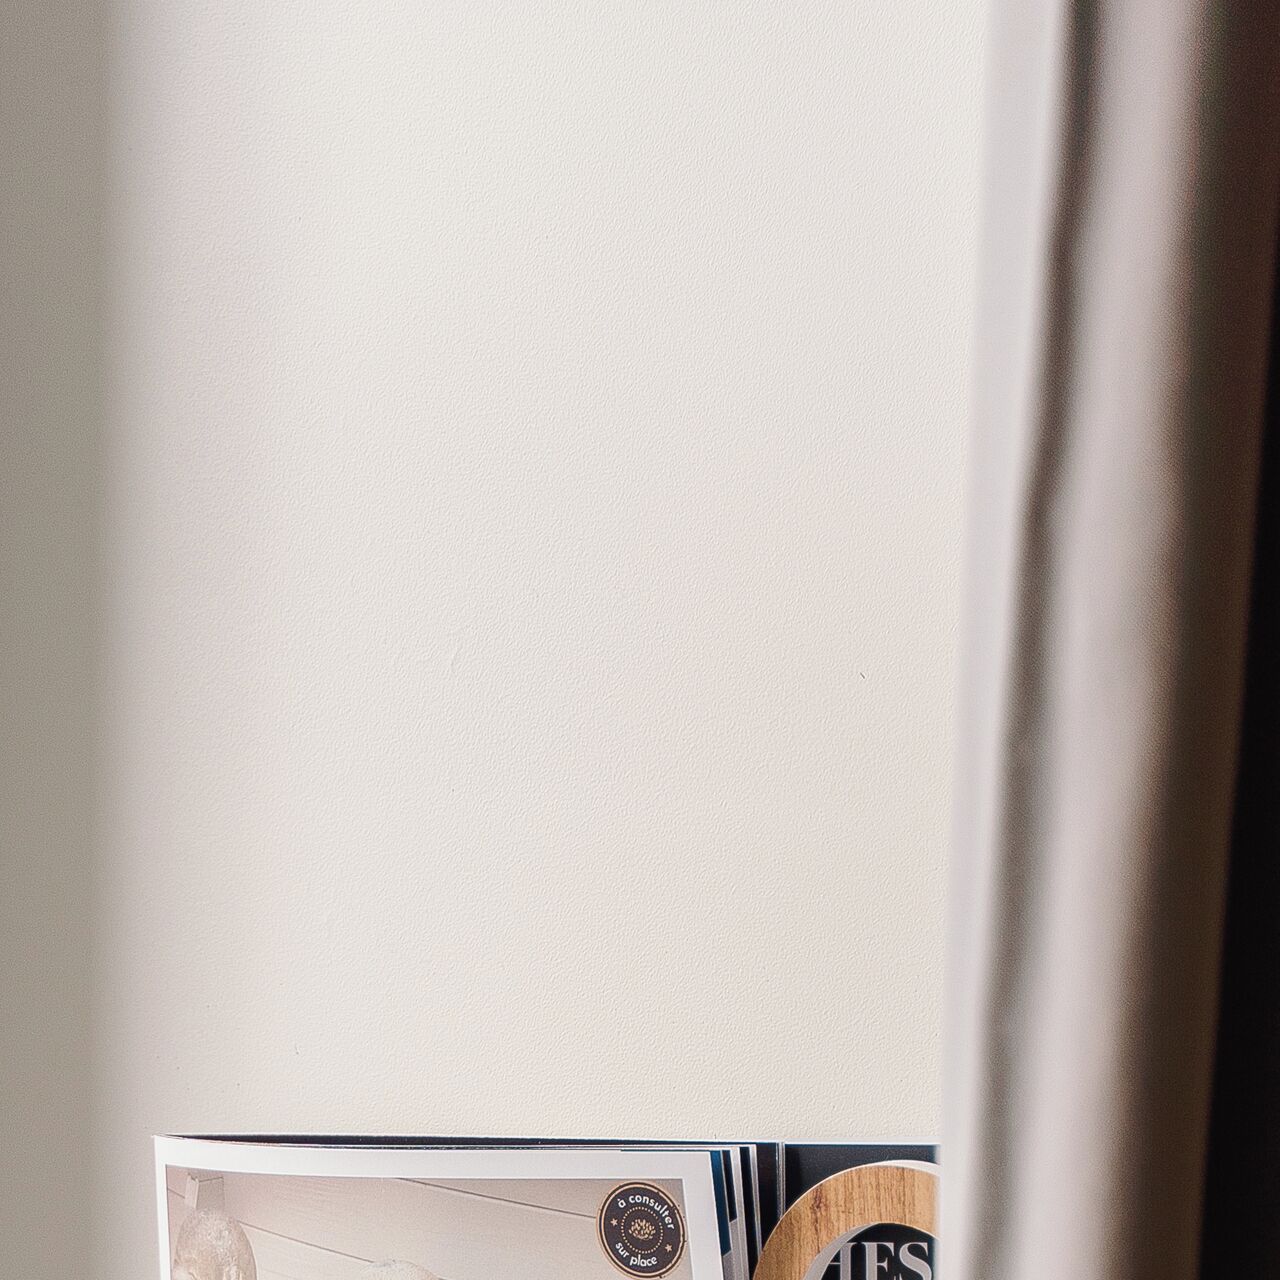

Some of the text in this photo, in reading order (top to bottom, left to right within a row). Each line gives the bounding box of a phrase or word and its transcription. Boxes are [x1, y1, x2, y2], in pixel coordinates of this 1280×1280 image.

[617, 1194, 675, 1230] à consulter
[615, 1242, 658, 1267] sur place
